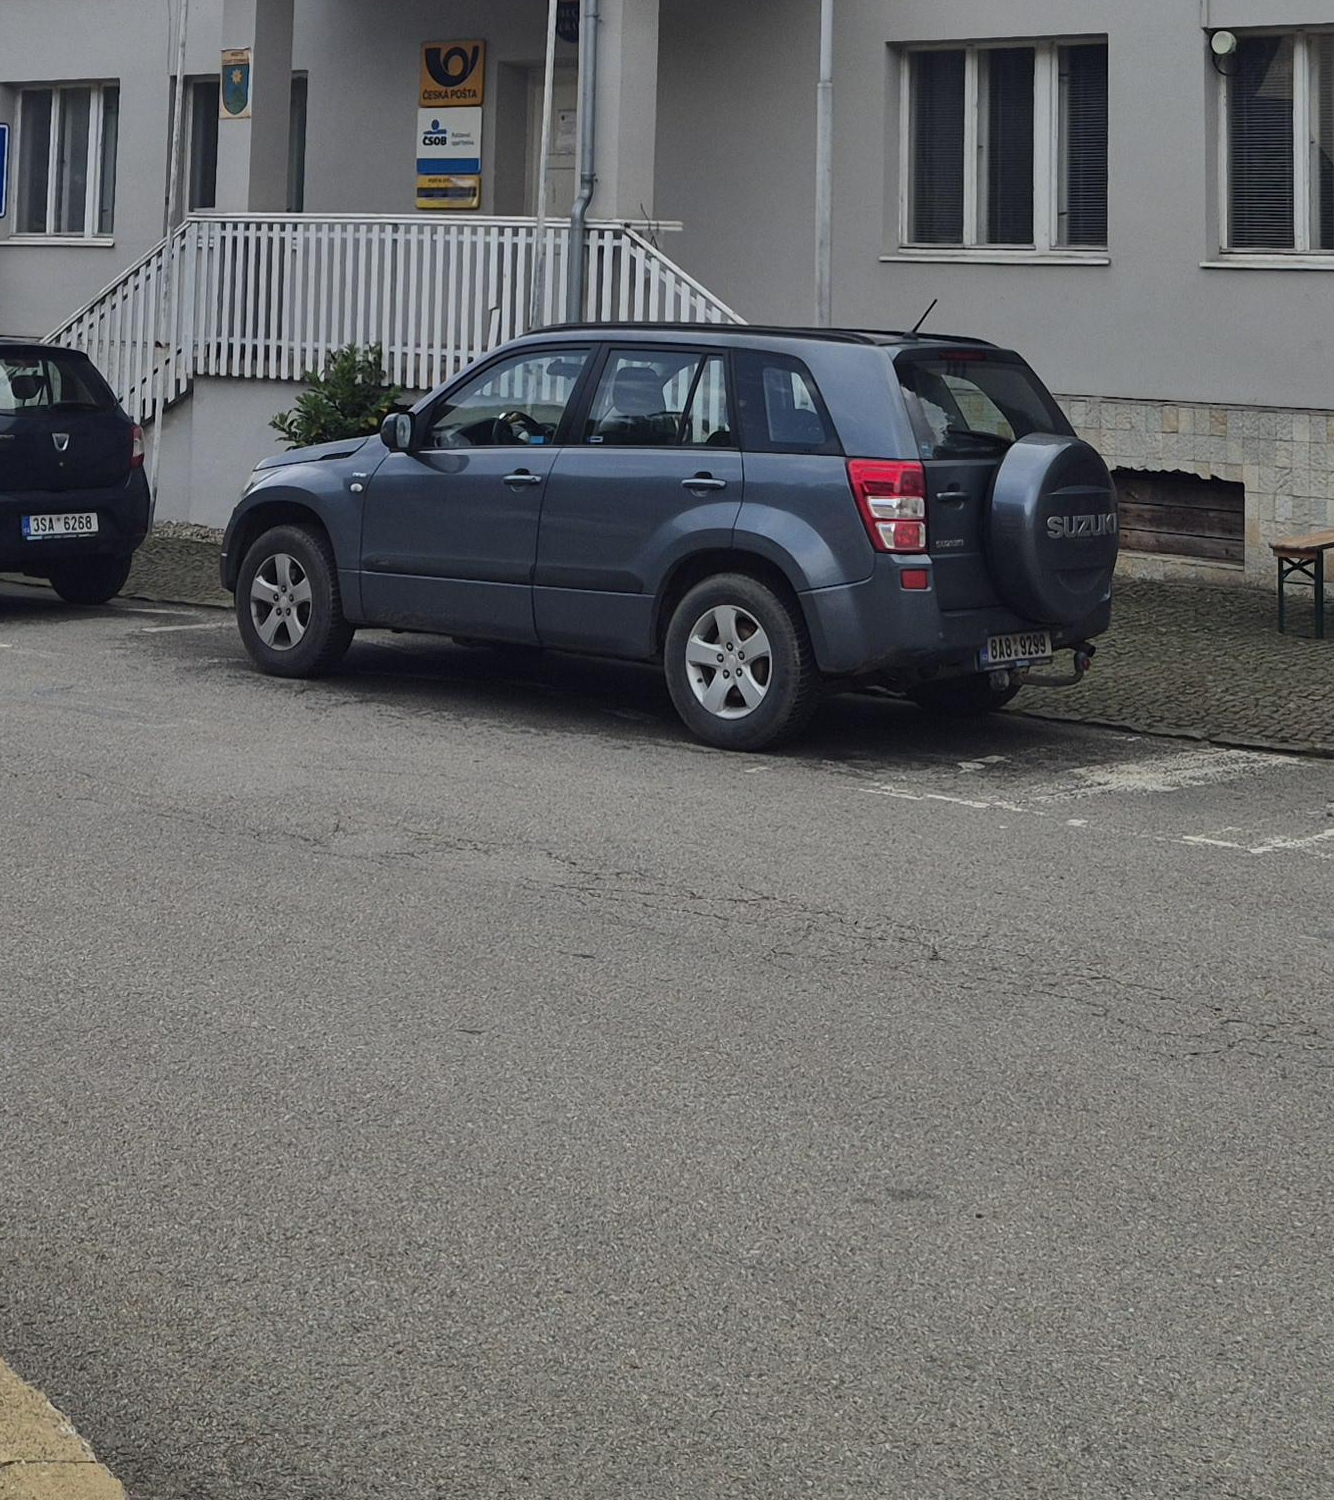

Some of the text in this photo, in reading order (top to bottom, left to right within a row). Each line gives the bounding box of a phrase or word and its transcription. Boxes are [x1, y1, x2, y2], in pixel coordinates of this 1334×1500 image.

[422, 88, 477, 101] ČESKÁ POŠTA
[422, 134, 447, 146] ČSOB
[33, 517, 55, 532] 3SA
[63, 515, 92, 531] 6268
[1046, 512, 1118, 540] SUZUKI
[1019, 633, 1047, 657] 9299
